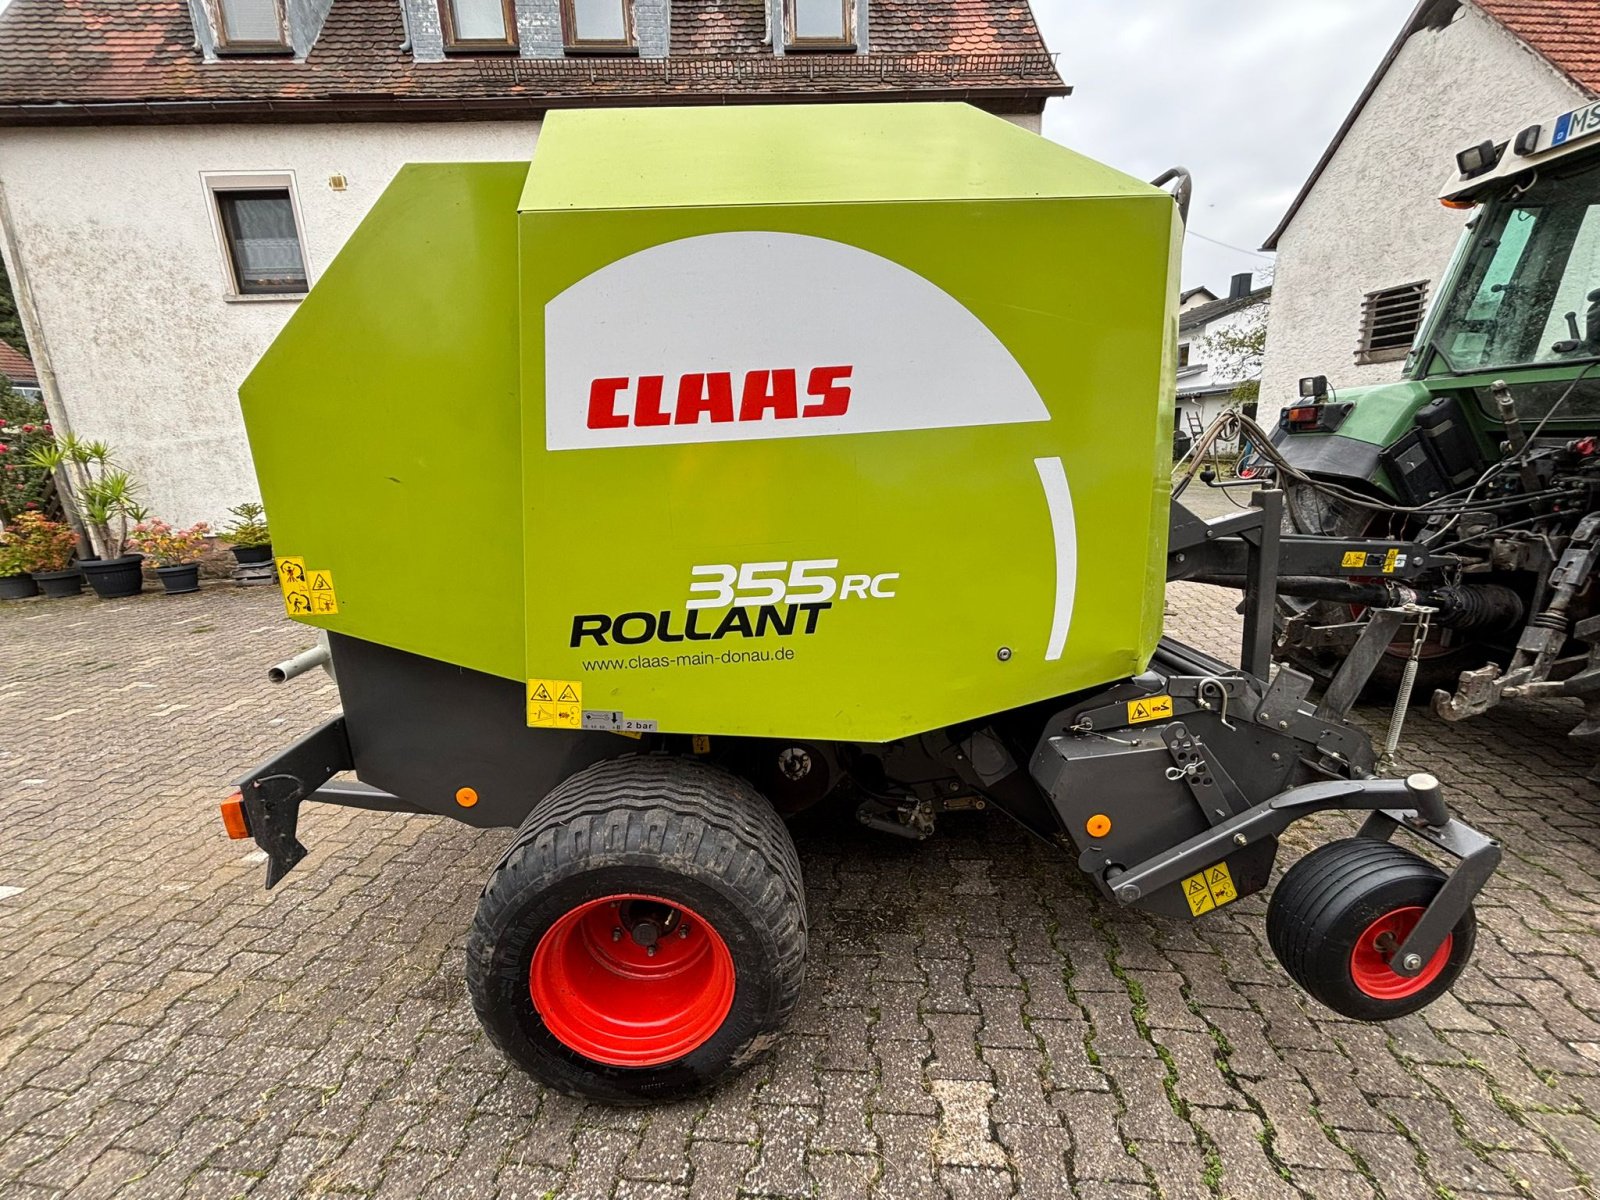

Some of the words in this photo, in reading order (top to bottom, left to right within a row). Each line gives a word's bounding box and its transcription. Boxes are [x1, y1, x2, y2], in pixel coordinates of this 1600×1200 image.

[1556, 132, 1564, 140] D
[587, 365, 853, 429] CLAAS
[686, 558, 839, 609] 355
[839, 572, 900, 600] RC
[569, 601, 833, 648] ROLLANT
[582, 647, 794, 671] www.claas-main-donau.de
[626, 721, 633, 729] 2
